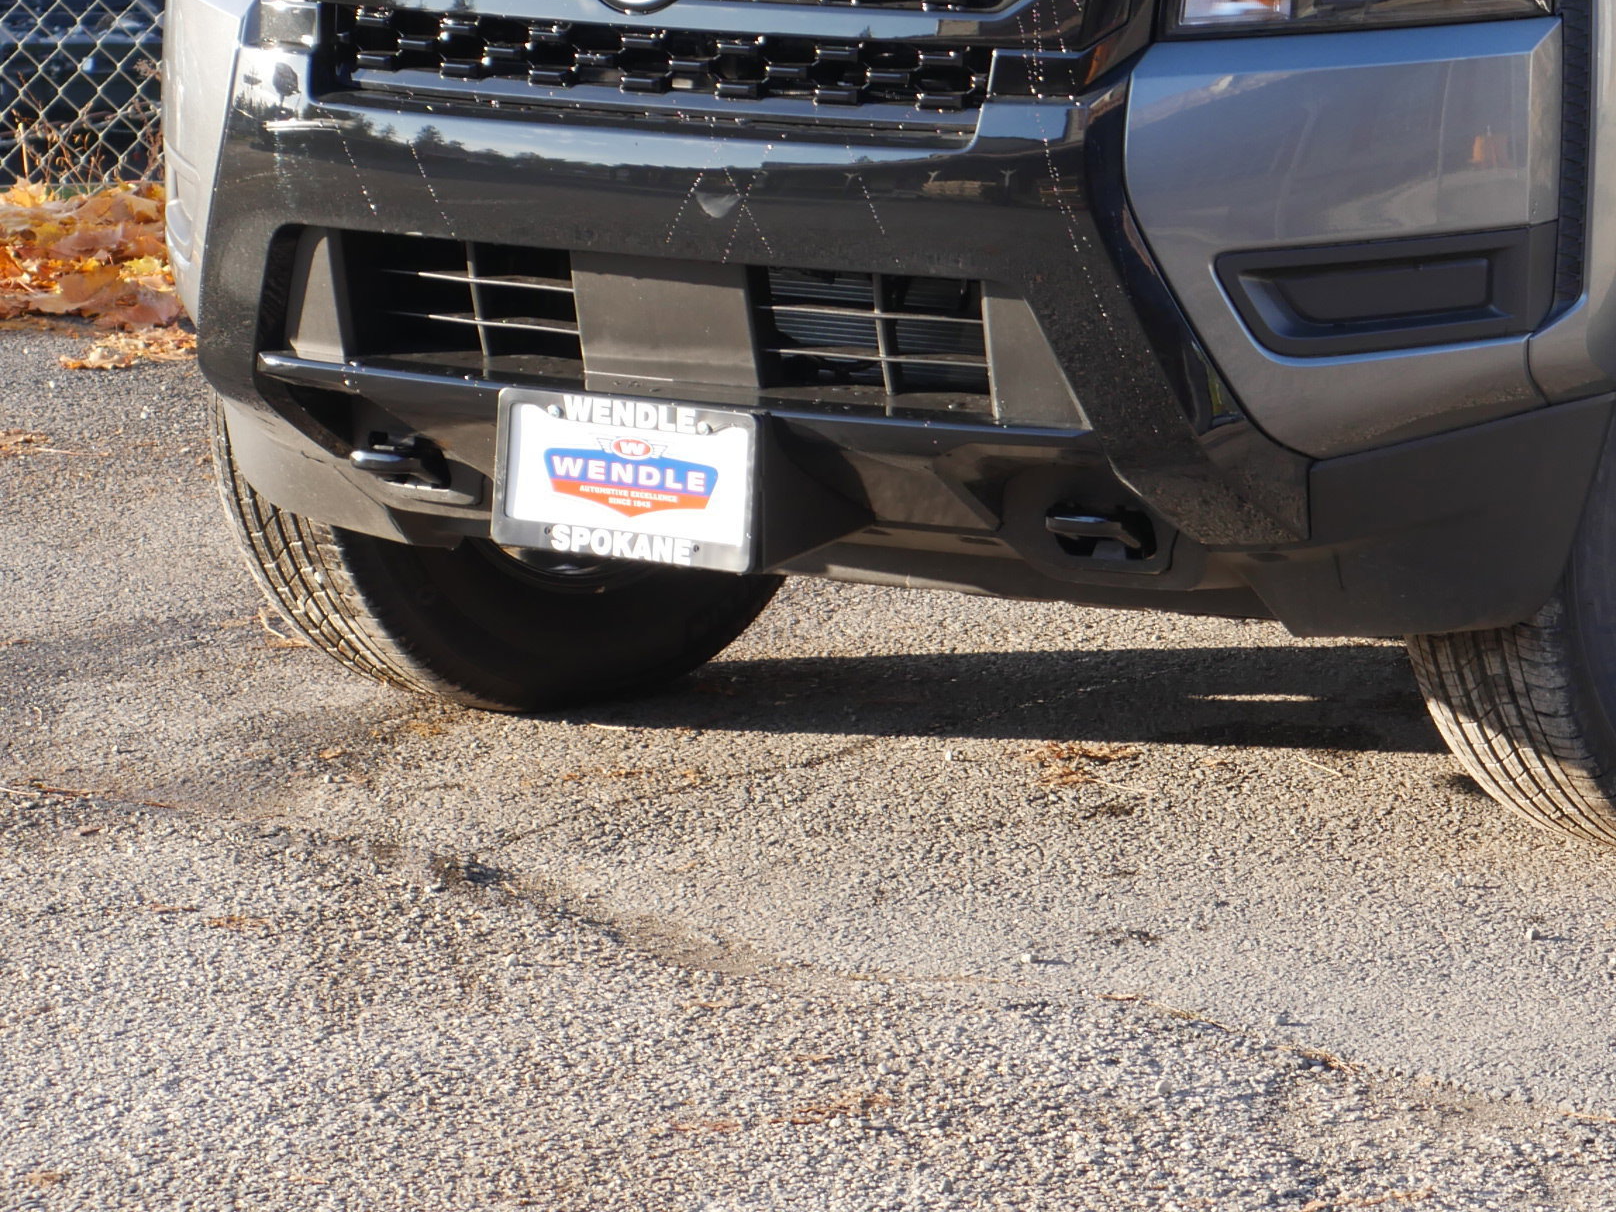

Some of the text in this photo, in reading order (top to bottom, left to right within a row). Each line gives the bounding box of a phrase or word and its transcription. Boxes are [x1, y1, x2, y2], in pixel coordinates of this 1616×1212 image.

[563, 394, 697, 435] WENDLE
[551, 455, 706, 493] WENDLE
[550, 524, 694, 566] SPOKANE
